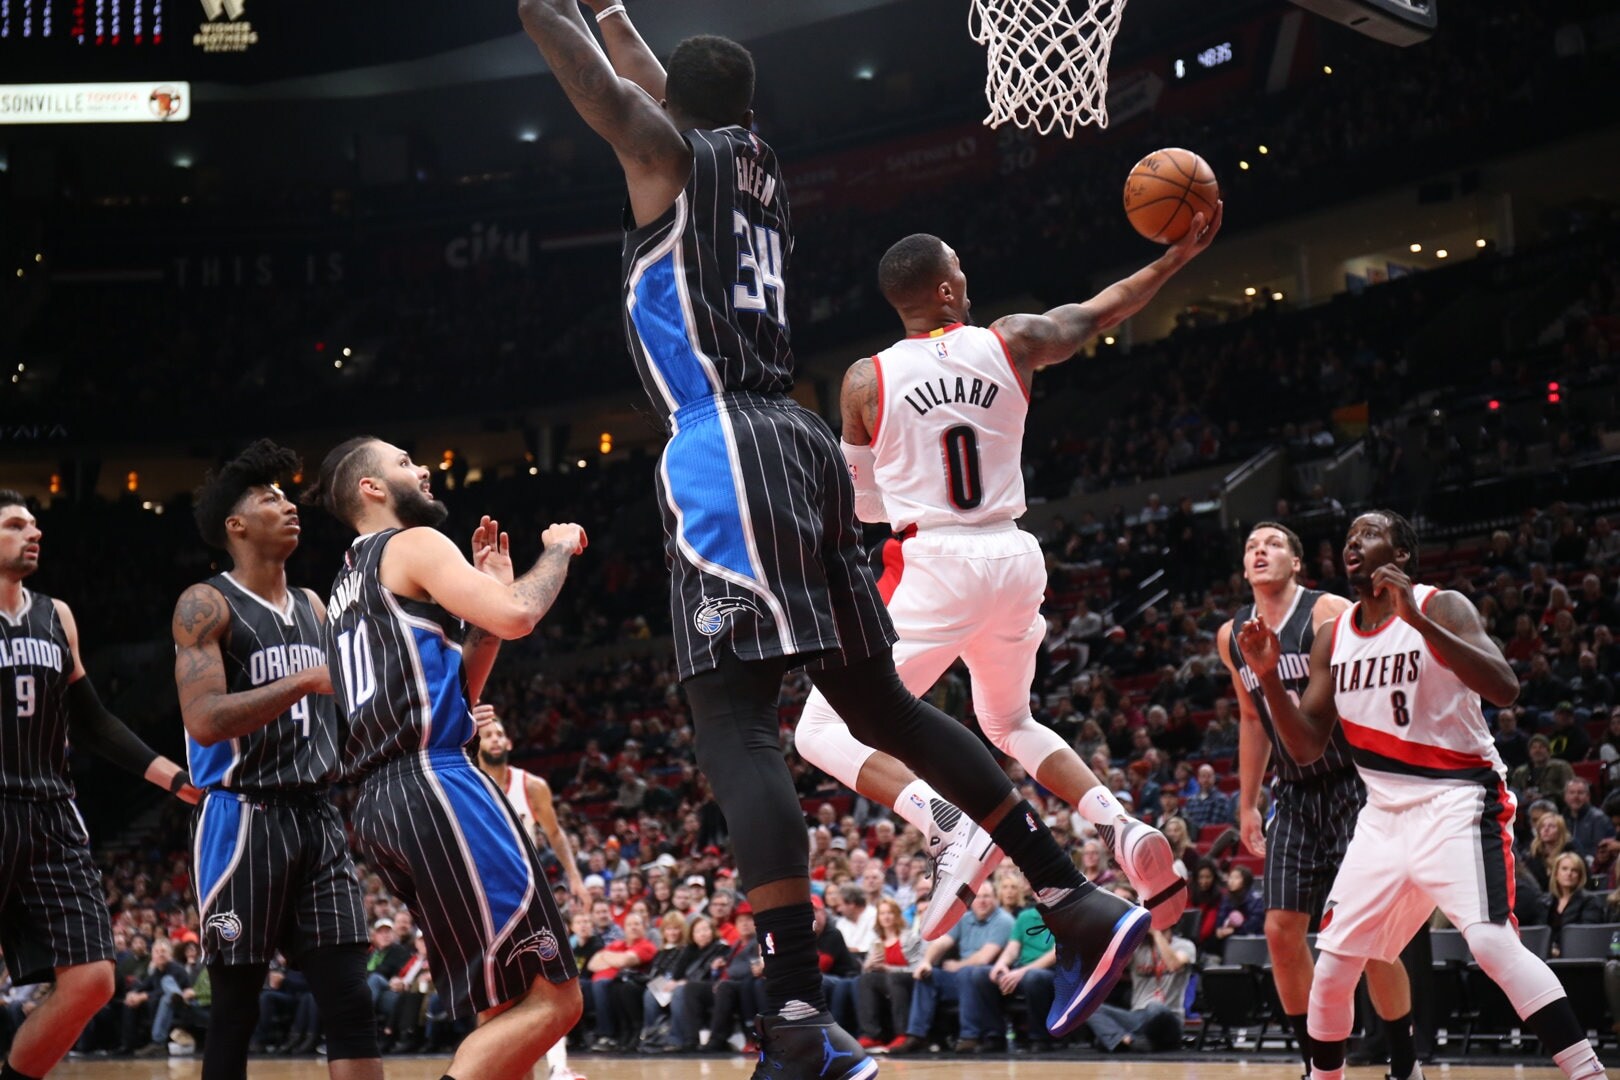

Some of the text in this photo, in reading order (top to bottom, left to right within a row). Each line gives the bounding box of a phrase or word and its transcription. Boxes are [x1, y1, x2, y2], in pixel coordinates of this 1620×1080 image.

[735, 156, 776, 207] GREEN
[174, 254, 273, 290] THIS
[305, 252, 343, 285] IS
[732, 207, 786, 330] 34
[905, 377, 999, 415] LILLARD
[940, 423, 985, 512] 0
[0, 637, 62, 673] LANDO
[337, 617, 377, 716] 10
[16, 674, 35, 717] 9
[291, 694, 310, 737] 4
[1391, 690, 1410, 727] 8
